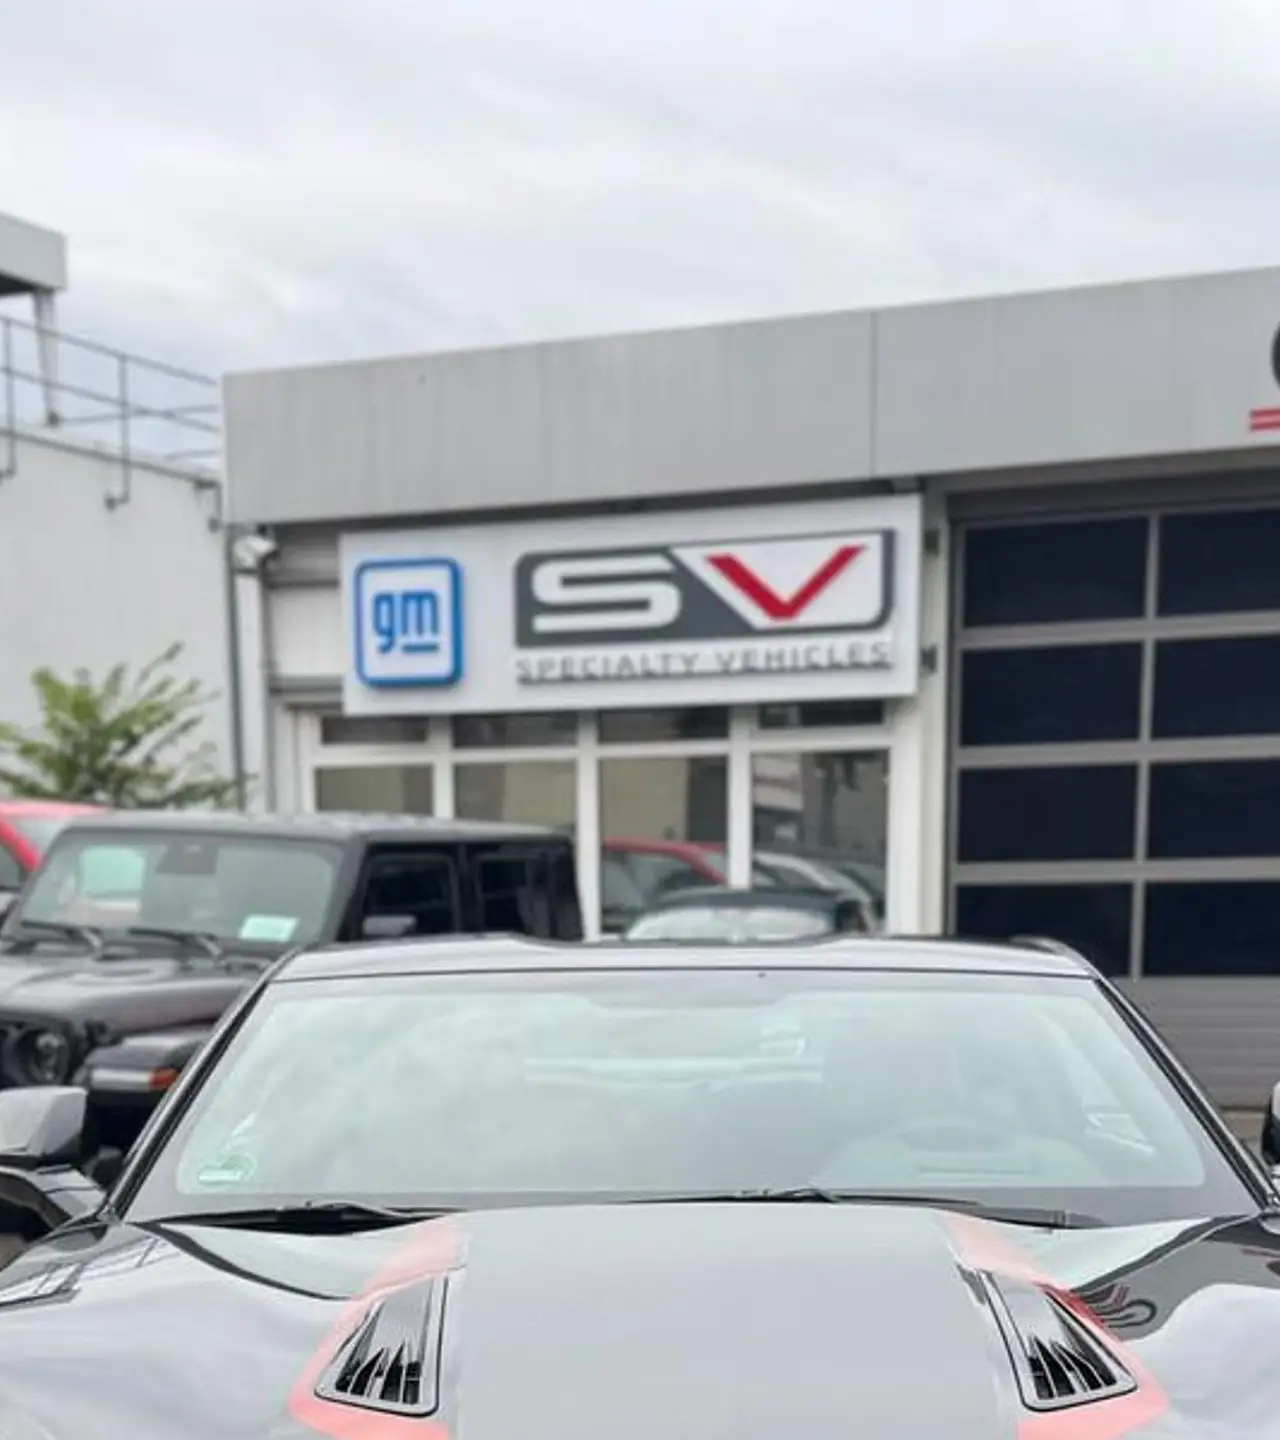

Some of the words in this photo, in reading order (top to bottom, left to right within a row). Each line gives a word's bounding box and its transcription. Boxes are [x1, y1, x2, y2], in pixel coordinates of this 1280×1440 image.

[371, 588, 441, 655] gm
[531, 544, 868, 633] SV
[516, 653, 702, 686] SPECIALTY
[720, 640, 893, 673] VEHICLES
